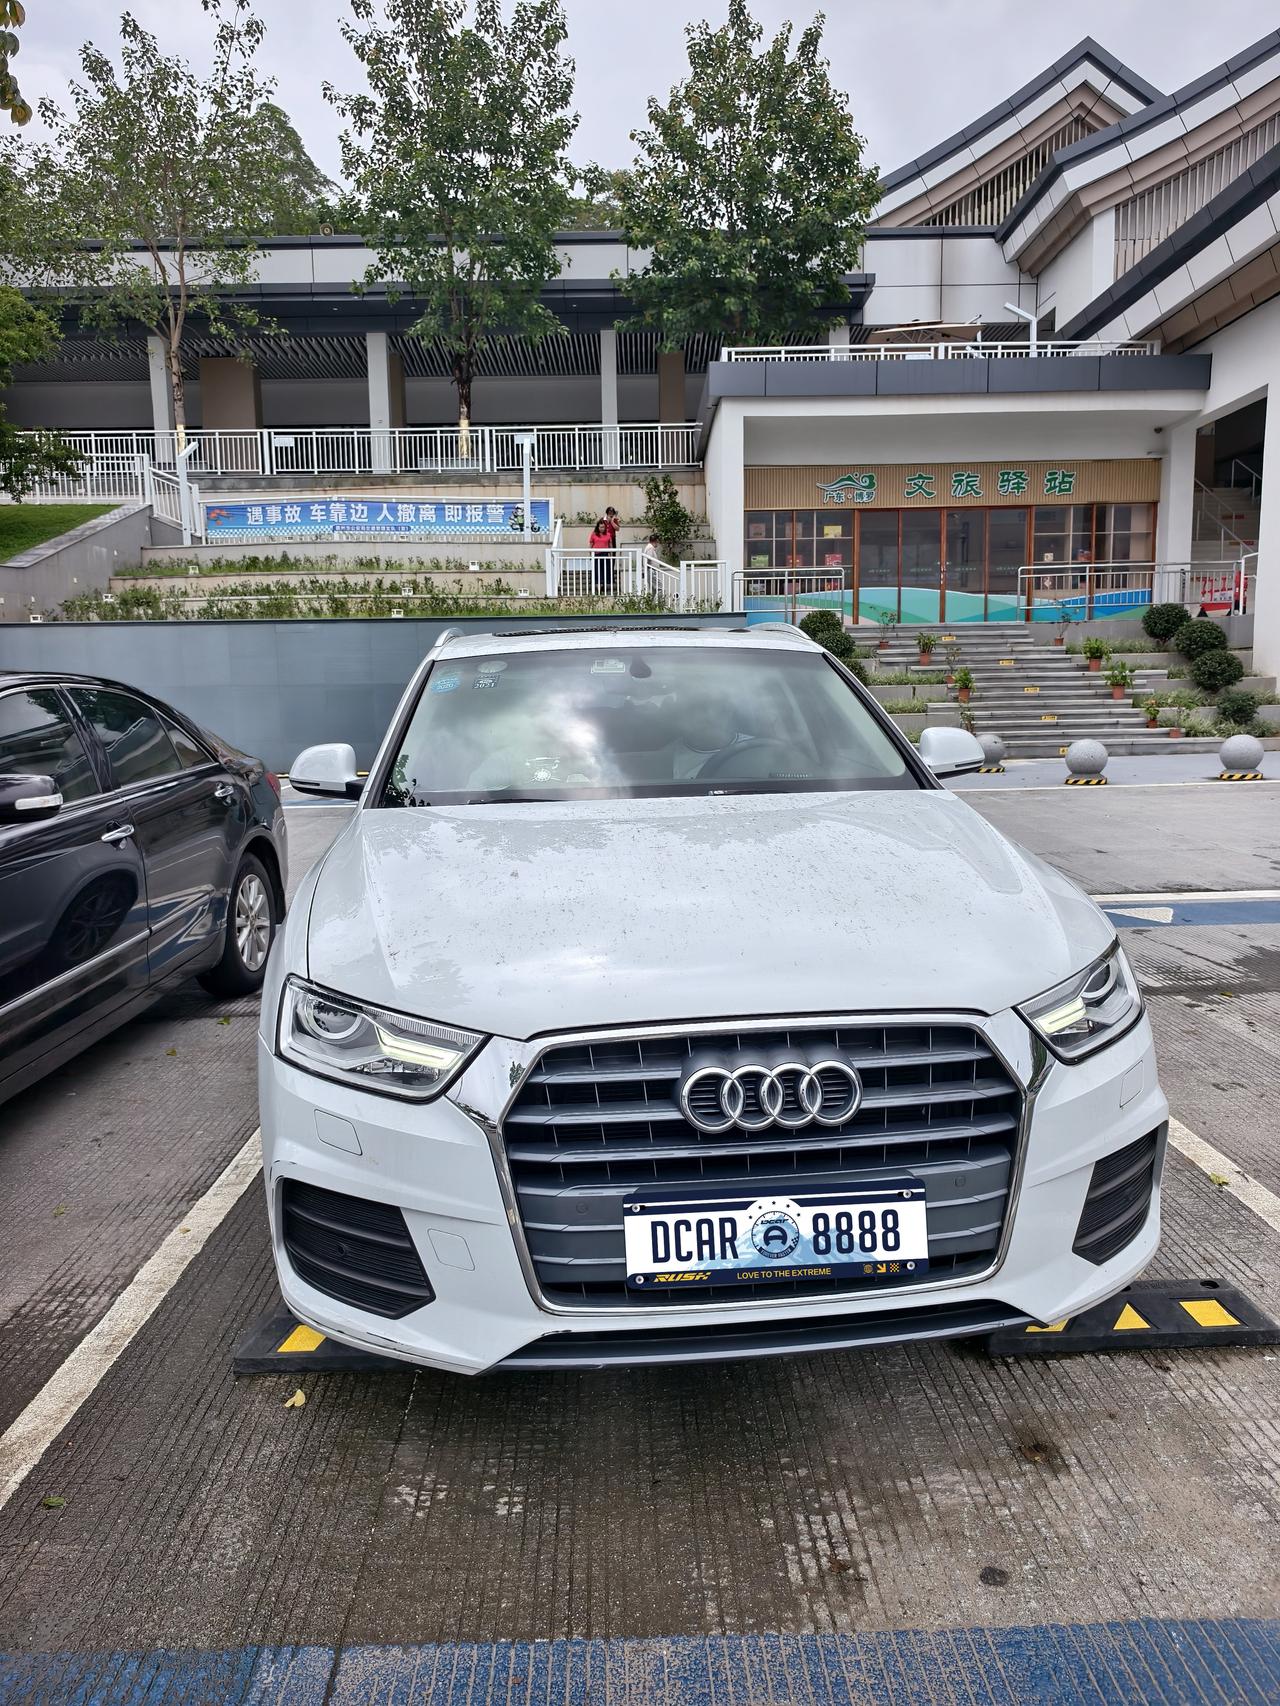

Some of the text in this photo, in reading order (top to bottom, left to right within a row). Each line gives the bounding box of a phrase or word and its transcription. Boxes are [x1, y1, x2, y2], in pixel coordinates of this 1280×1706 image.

[904, 470, 1076, 499] 文旅驿站
[246, 503, 505, 525] 遇事故 车靠边 人撤离 即报警
[650, 1209, 901, 1263] DCAR 8888
[653, 1271, 712, 1283] RUSH
[737, 1268, 832, 1280] LOVE TO THE EXTREME
